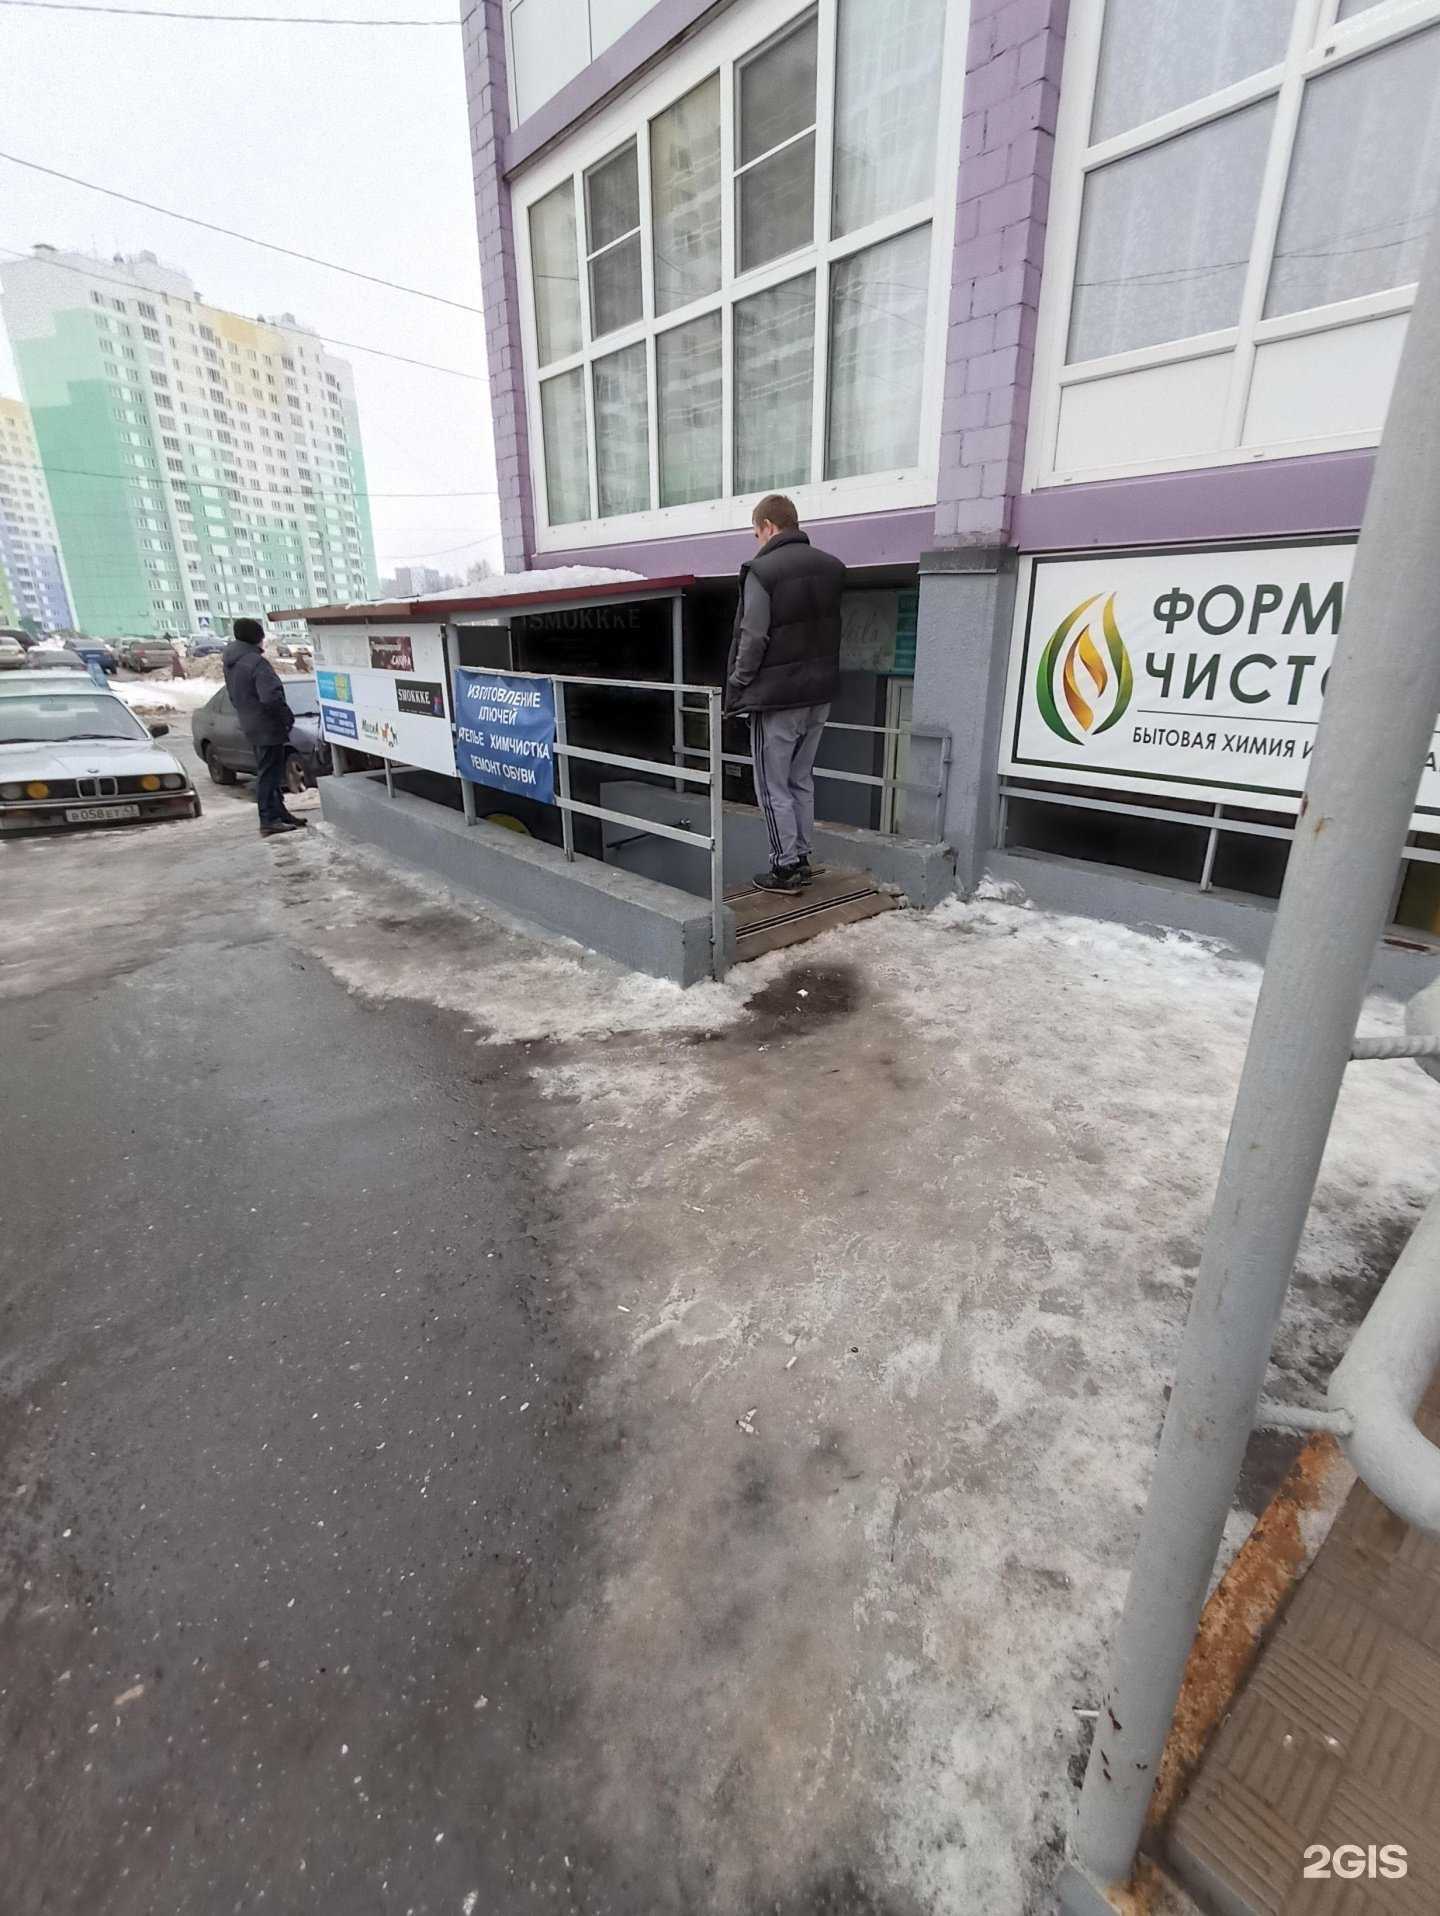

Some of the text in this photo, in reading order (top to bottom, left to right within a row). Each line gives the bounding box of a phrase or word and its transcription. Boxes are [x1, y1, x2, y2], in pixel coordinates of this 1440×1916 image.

[1153, 581, 1344, 635] ФОРМ
[1145, 652, 1332, 706] ЧИСТ
[398, 688, 431, 705] SMOKKKE
[467, 684, 541, 708] ИЗГОТОВЛЕНИЕ
[490, 734, 550, 760] ХИМЧИСТКА
[1133, 727, 1216, 750] БЫТОВАЯ
[1222, 734, 1295, 758] ХИМИЯ
[502, 763, 536, 785] ОБУВИ
